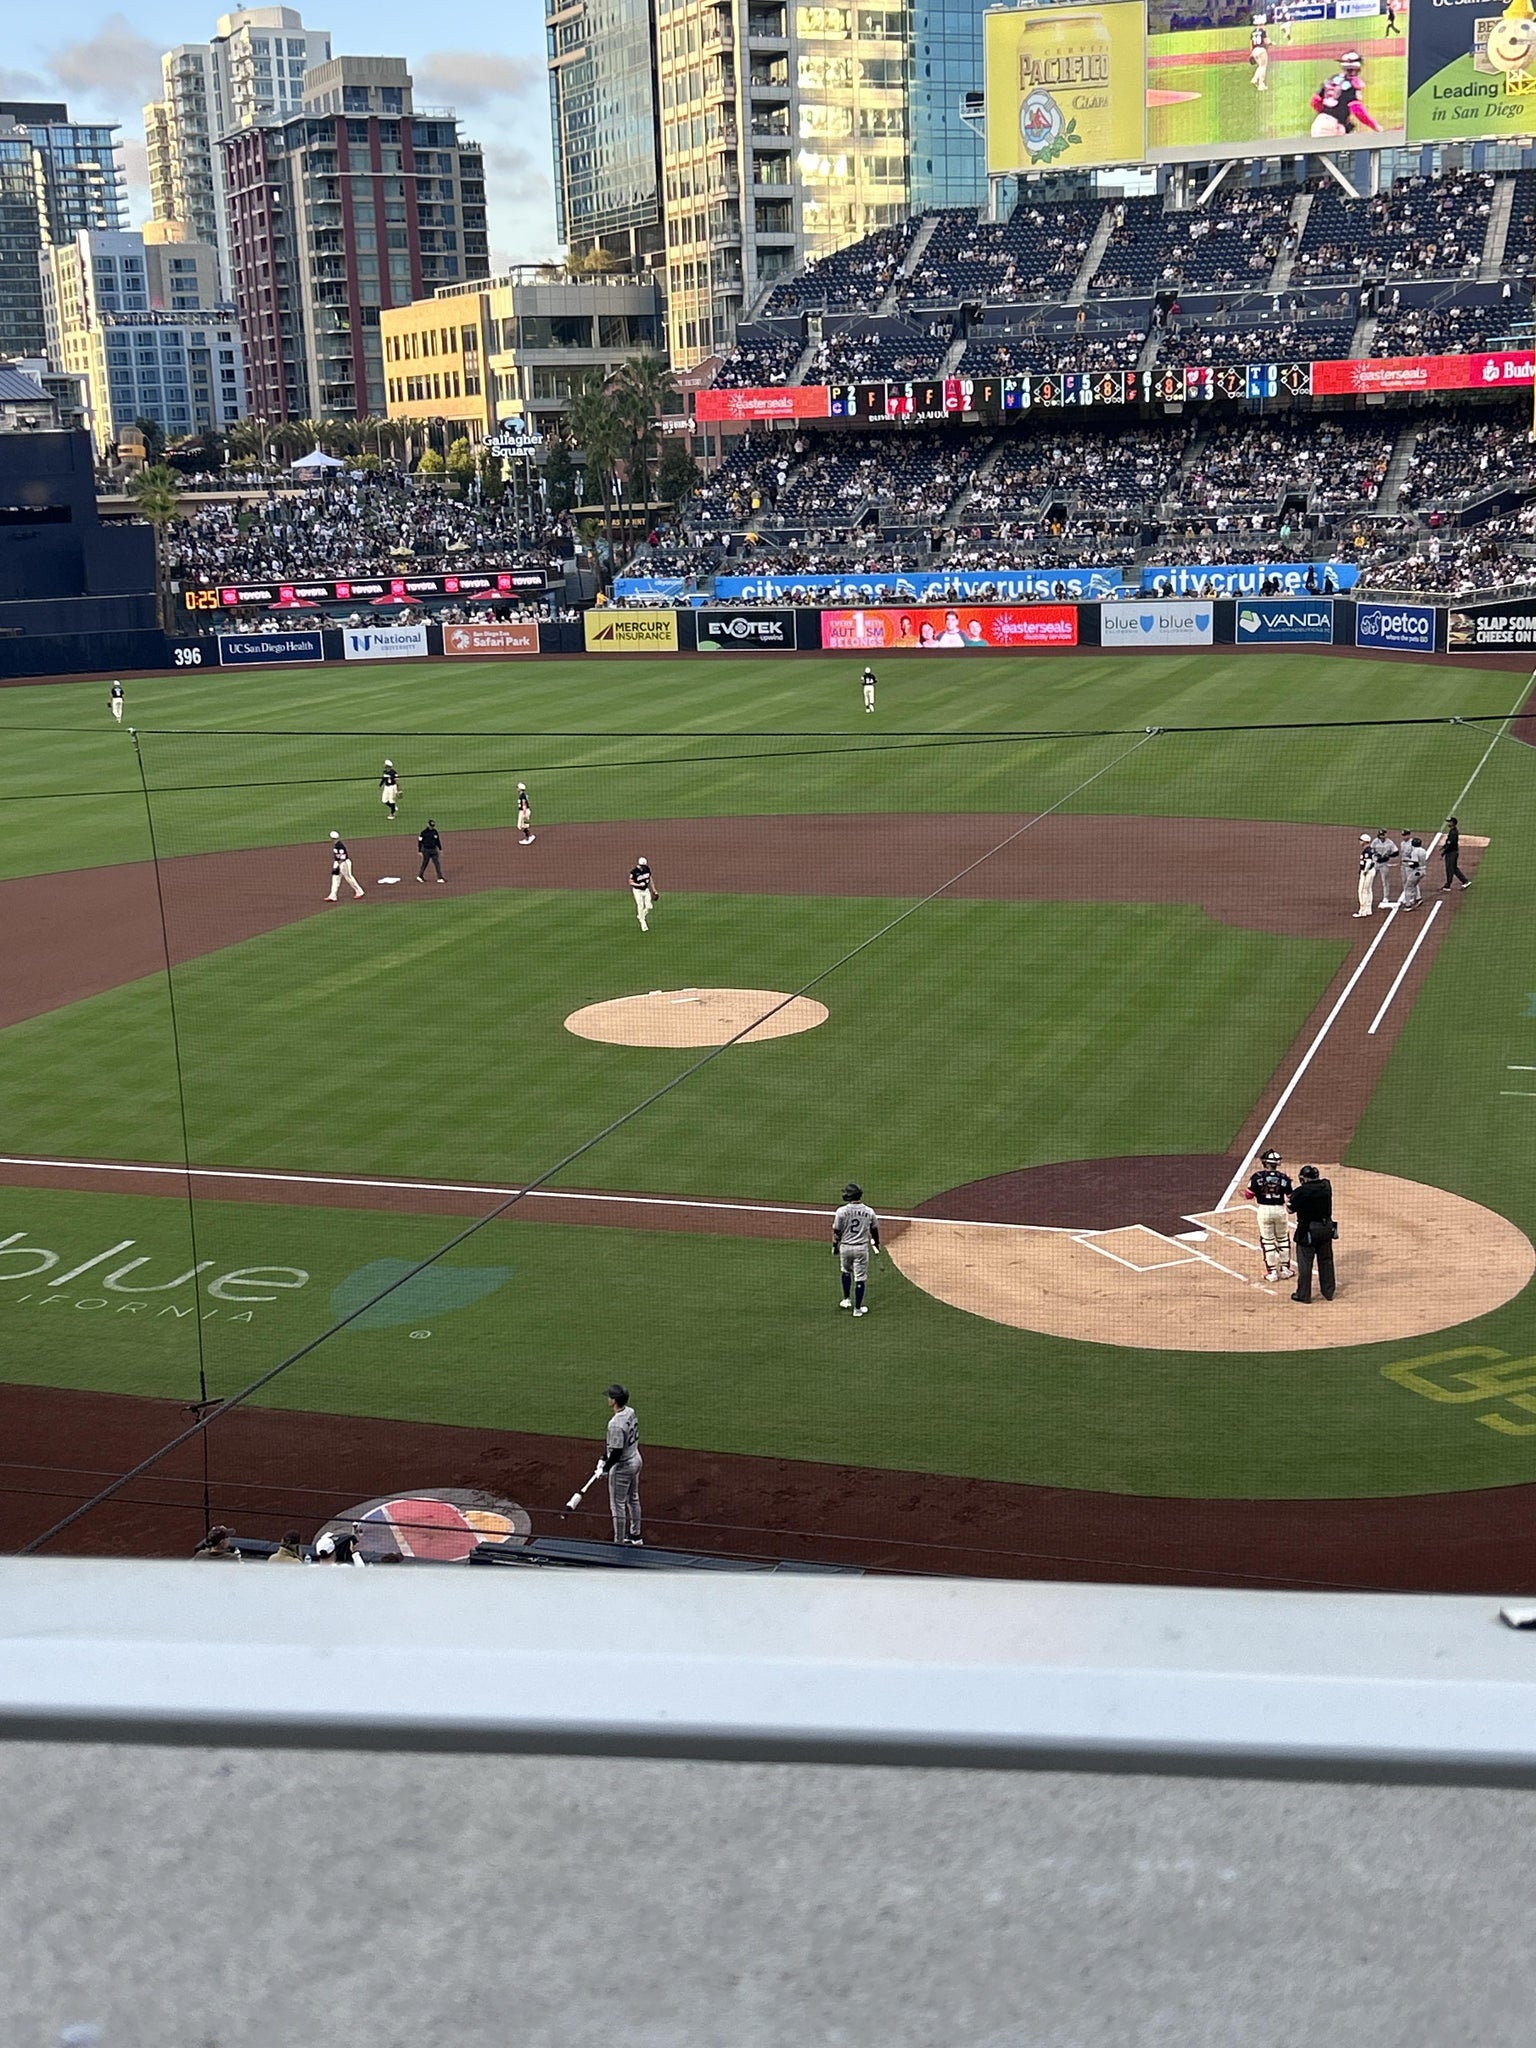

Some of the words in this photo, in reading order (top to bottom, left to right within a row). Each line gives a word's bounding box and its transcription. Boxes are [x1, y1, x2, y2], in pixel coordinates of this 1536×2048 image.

[1019, 54, 1109, 91] PACIFICO
[1433, 82, 1498, 99] Leading
[1431, 107, 1446, 121] in
[1451, 105, 1479, 120] San
[1484, 102, 1524, 119] Diego
[1142, 372, 1152, 386] 6
[1204, 369, 1214, 384] 2
[1268, 366, 1277, 380] 0
[1292, 372, 1298, 388] 1
[1359, 367, 1428, 380] easterseals
[960, 380, 974, 396] 10
[1022, 378, 1030, 392] 4
[1082, 374, 1091, 390] 5
[1103, 382, 1112, 396] 8
[1165, 378, 1173, 394] 8
[1228, 376, 1236, 390] 7
[1268, 382, 1277, 397] 0
[832, 388, 841, 400] P
[847, 386, 856, 400] 2
[904, 382, 913, 398] 5
[926, 389, 934, 404] F
[984, 386, 992, 402] F
[1043, 384, 1051, 400] 9
[1144, 387, 1150, 402] 1
[1204, 385, 1214, 400] 3
[868, 392, 876, 407] F
[904, 398, 914, 412] 4
[963, 396, 972, 410] 2
[1022, 392, 1030, 408] 0
[1079, 390, 1092, 406] 10
[848, 401, 856, 416] 0
[482, 429, 544, 447] Gallagher
[492, 446, 536, 458] Square
[238, 592, 272, 600] TOYOTA
[296, 588, 328, 597] TOYOTA
[352, 586, 383, 594] TOYOTA
[406, 582, 437, 591] TOYOTA
[460, 580, 490, 588] TOYOTA
[512, 576, 542, 586] TOYOTA
[742, 579, 886, 600] citycrises
[186, 591, 218, 610] 0:25
[616, 622, 670, 632] MERCURY
[708, 618, 783, 638] EVOTEK
[1002, 620, 1072, 634] easterseals
[1104, 616, 1138, 629] blue
[1160, 616, 1194, 628] blue
[1262, 614, 1331, 627] VANDA
[1381, 612, 1429, 636] petco
[1476, 616, 1508, 630] SLAP
[1509, 616, 1536, 630] SOM
[374, 633, 421, 644] National
[473, 636, 504, 648] Safari
[506, 637, 530, 647] Park
[616, 632, 672, 640] INSURANCE
[760, 634, 784, 642] upwind
[830, 638, 882, 647] BELONGS
[1476, 630, 1514, 642] CHEESE
[1515, 630, 1531, 642] ON
[228, 644, 244, 654] UC
[244, 643, 260, 653] San
[262, 642, 286, 654] Diego
[286, 640, 314, 652] Health
[174, 648, 202, 666] 396
[850, 1218, 860, 1234] 2
[0, 1233, 309, 1301] blue
